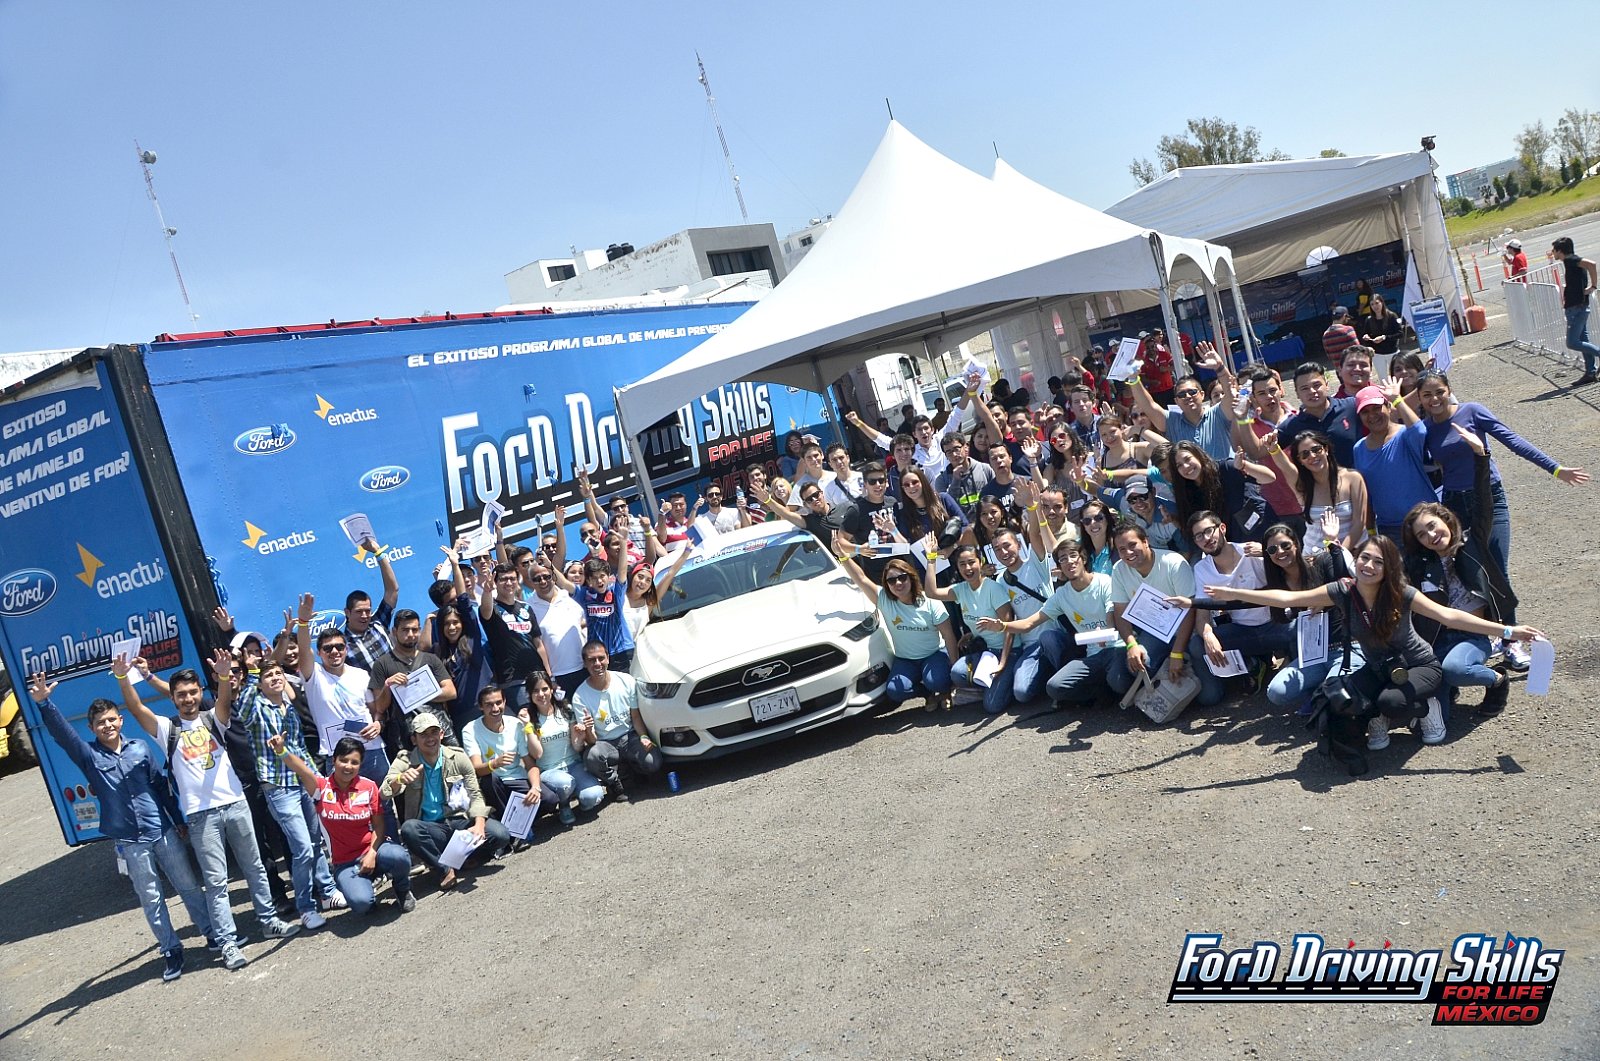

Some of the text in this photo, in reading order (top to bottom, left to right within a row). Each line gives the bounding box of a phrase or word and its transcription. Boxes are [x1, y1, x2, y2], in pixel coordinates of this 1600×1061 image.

[407, 354, 430, 368] EL
[433, 345, 499, 365] EXITOSO
[502, 337, 580, 357] PROGRAMA
[582, 333, 627, 348] GLOBAL
[629, 331, 643, 343] DE
[644, 326, 687, 341] MANEJO
[2, 399, 67, 440] EXITOSO
[46, 409, 111, 448] GLOBAL
[327, 406, 378, 427] enactus
[701, 380, 773, 441] Skills
[246, 430, 286, 452] Ford
[707, 431, 774, 470] FOR LIFE
[16, 447, 85, 487] MANEJO
[370, 469, 402, 490] Ford
[0, 481, 66, 519] VENTIVO
[68, 471, 91, 493] DE
[257, 529, 316, 556] enactus
[2, 576, 46, 612] Ford
[127, 609, 179, 646] Skills
[155, 639, 179, 652] LIFE
[896, 624, 930, 632] enactus
